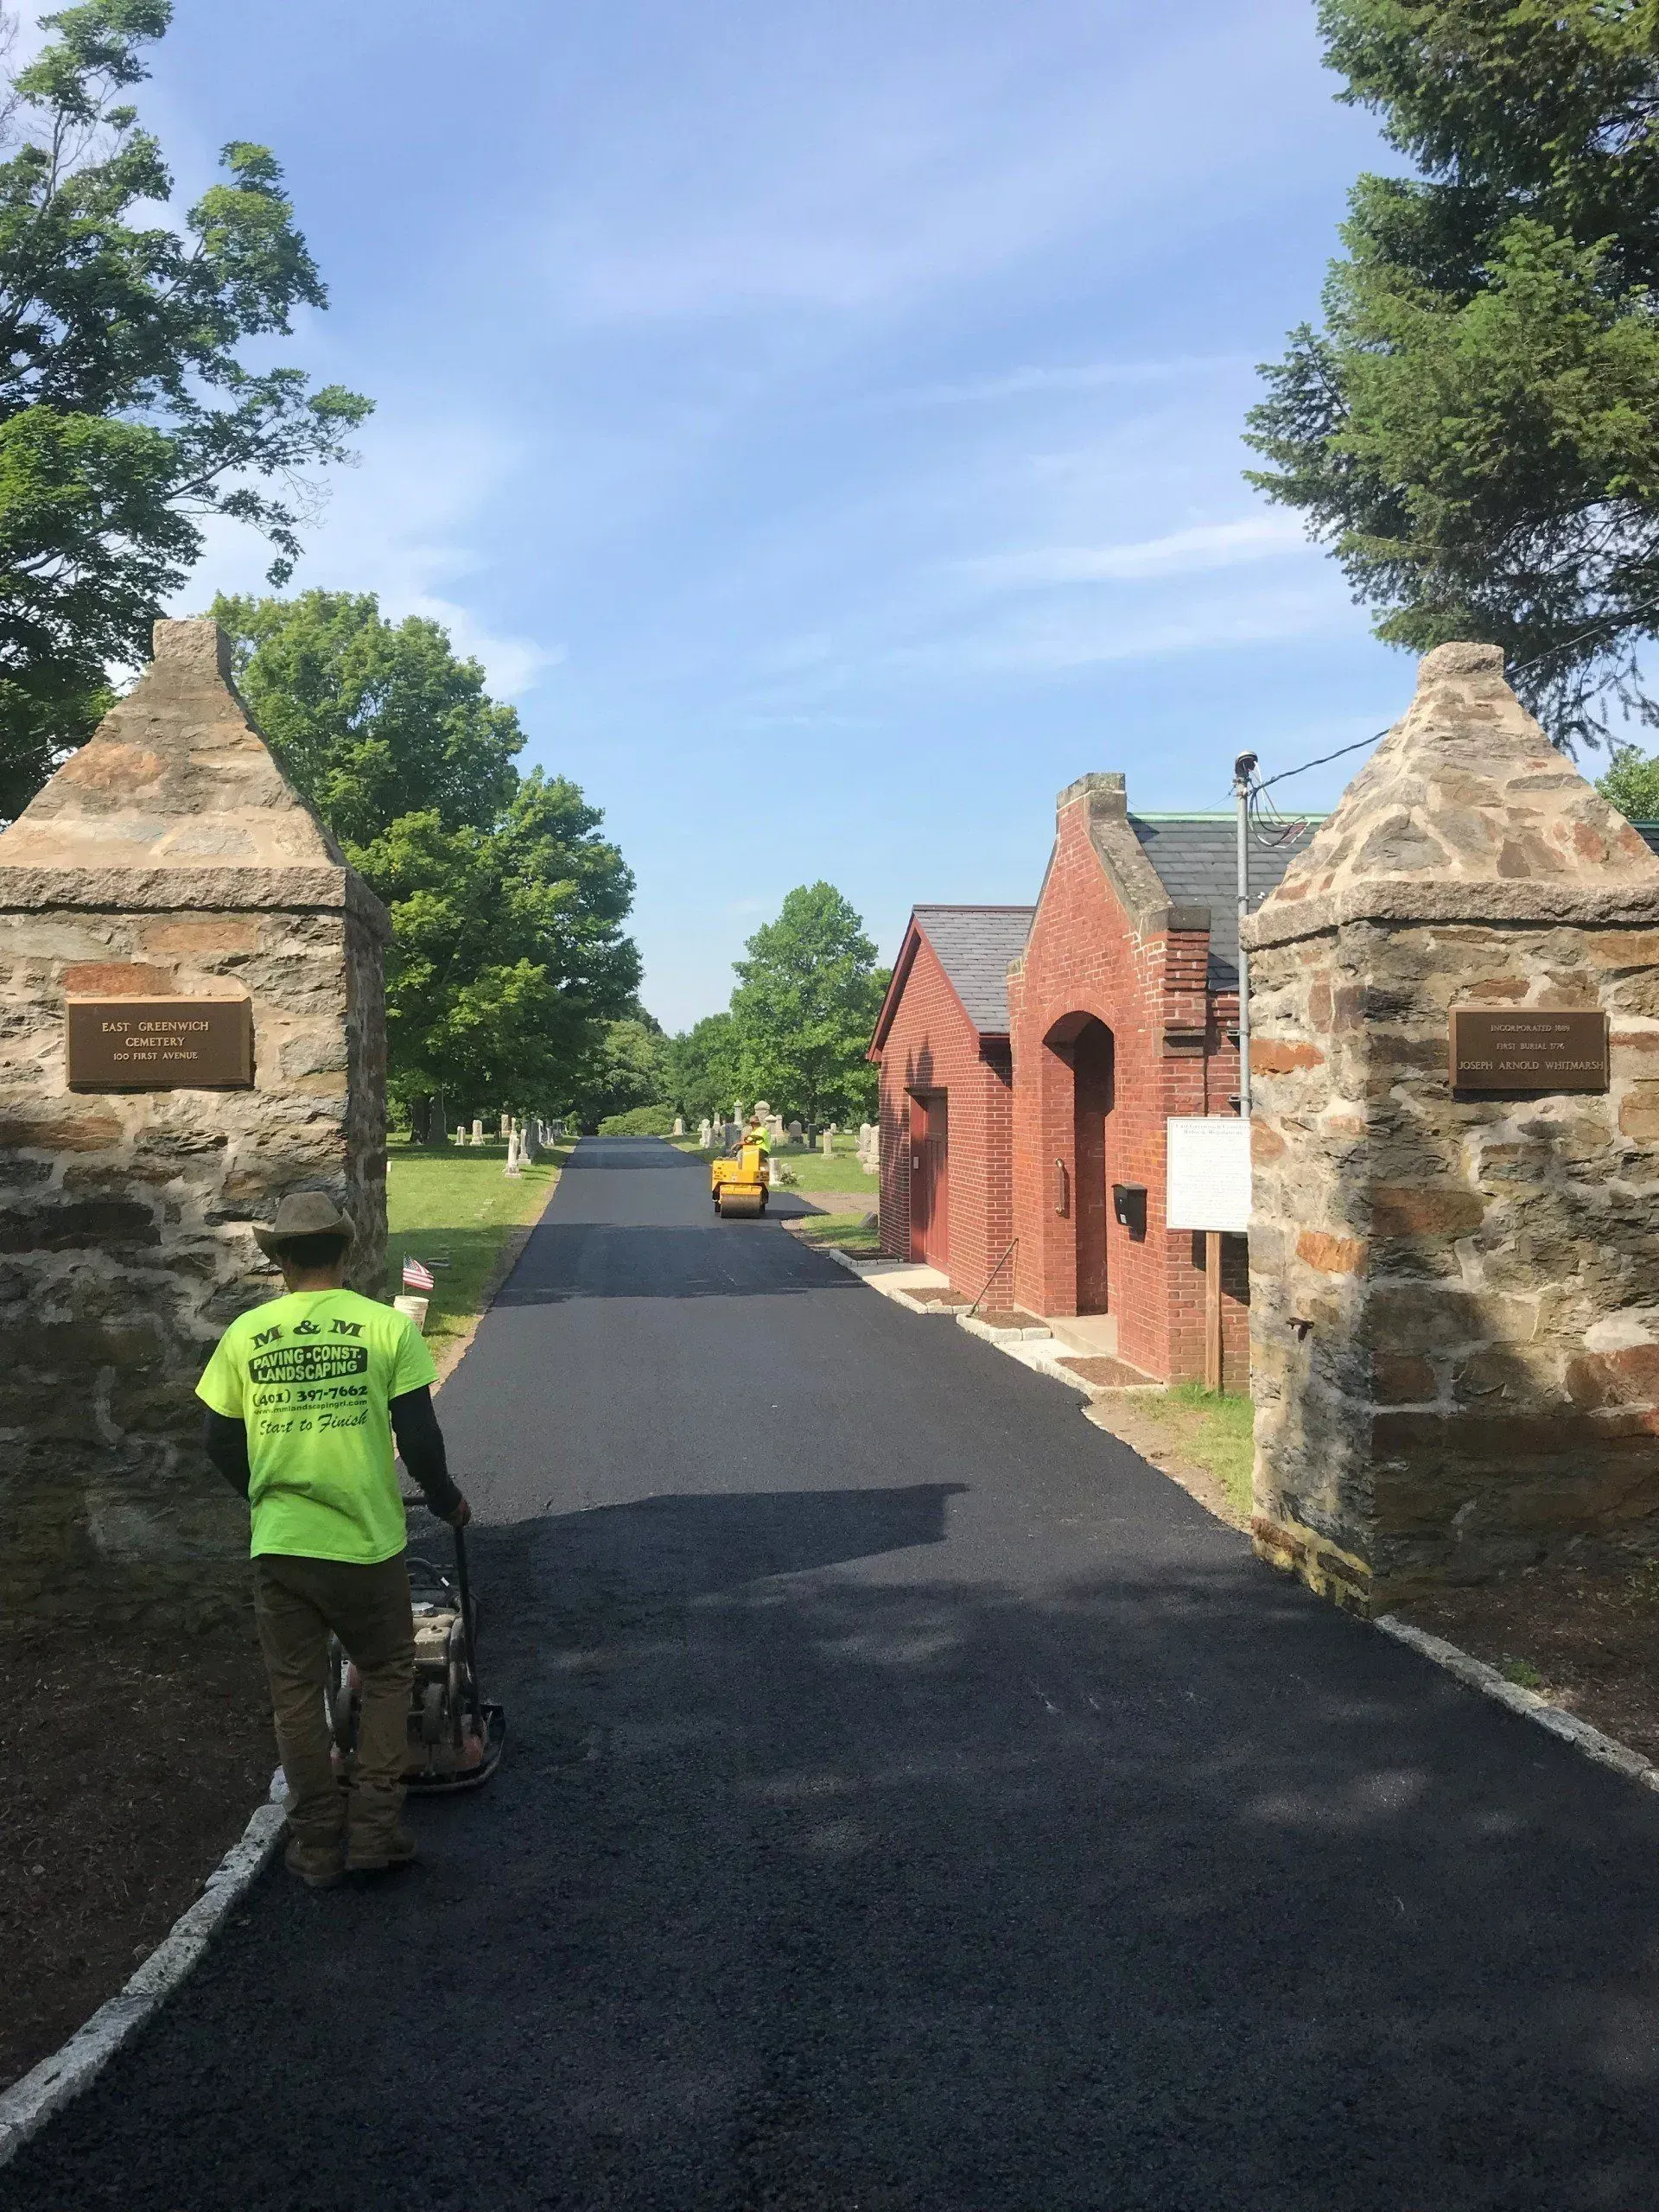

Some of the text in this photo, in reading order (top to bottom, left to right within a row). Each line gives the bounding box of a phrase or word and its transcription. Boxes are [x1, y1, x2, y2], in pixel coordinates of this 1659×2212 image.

[102, 1021, 209, 1033] EAST GREENWICH
[125, 1037, 185, 1048] CEMETERY
[113, 1051, 198, 1061] 100 FIRST AVENUE
[1459, 1061, 1604, 1071] JOSEPH ARNOLD WHITMARSH
[250, 1319, 365, 1351] M & M
[254, 1349, 304, 1370] PAVING
[257, 1361, 358, 1382] LANDSCAPING
[252, 1385, 368, 1407] (401) 397-7662
[260, 1408, 369, 1435] Start to Finish
